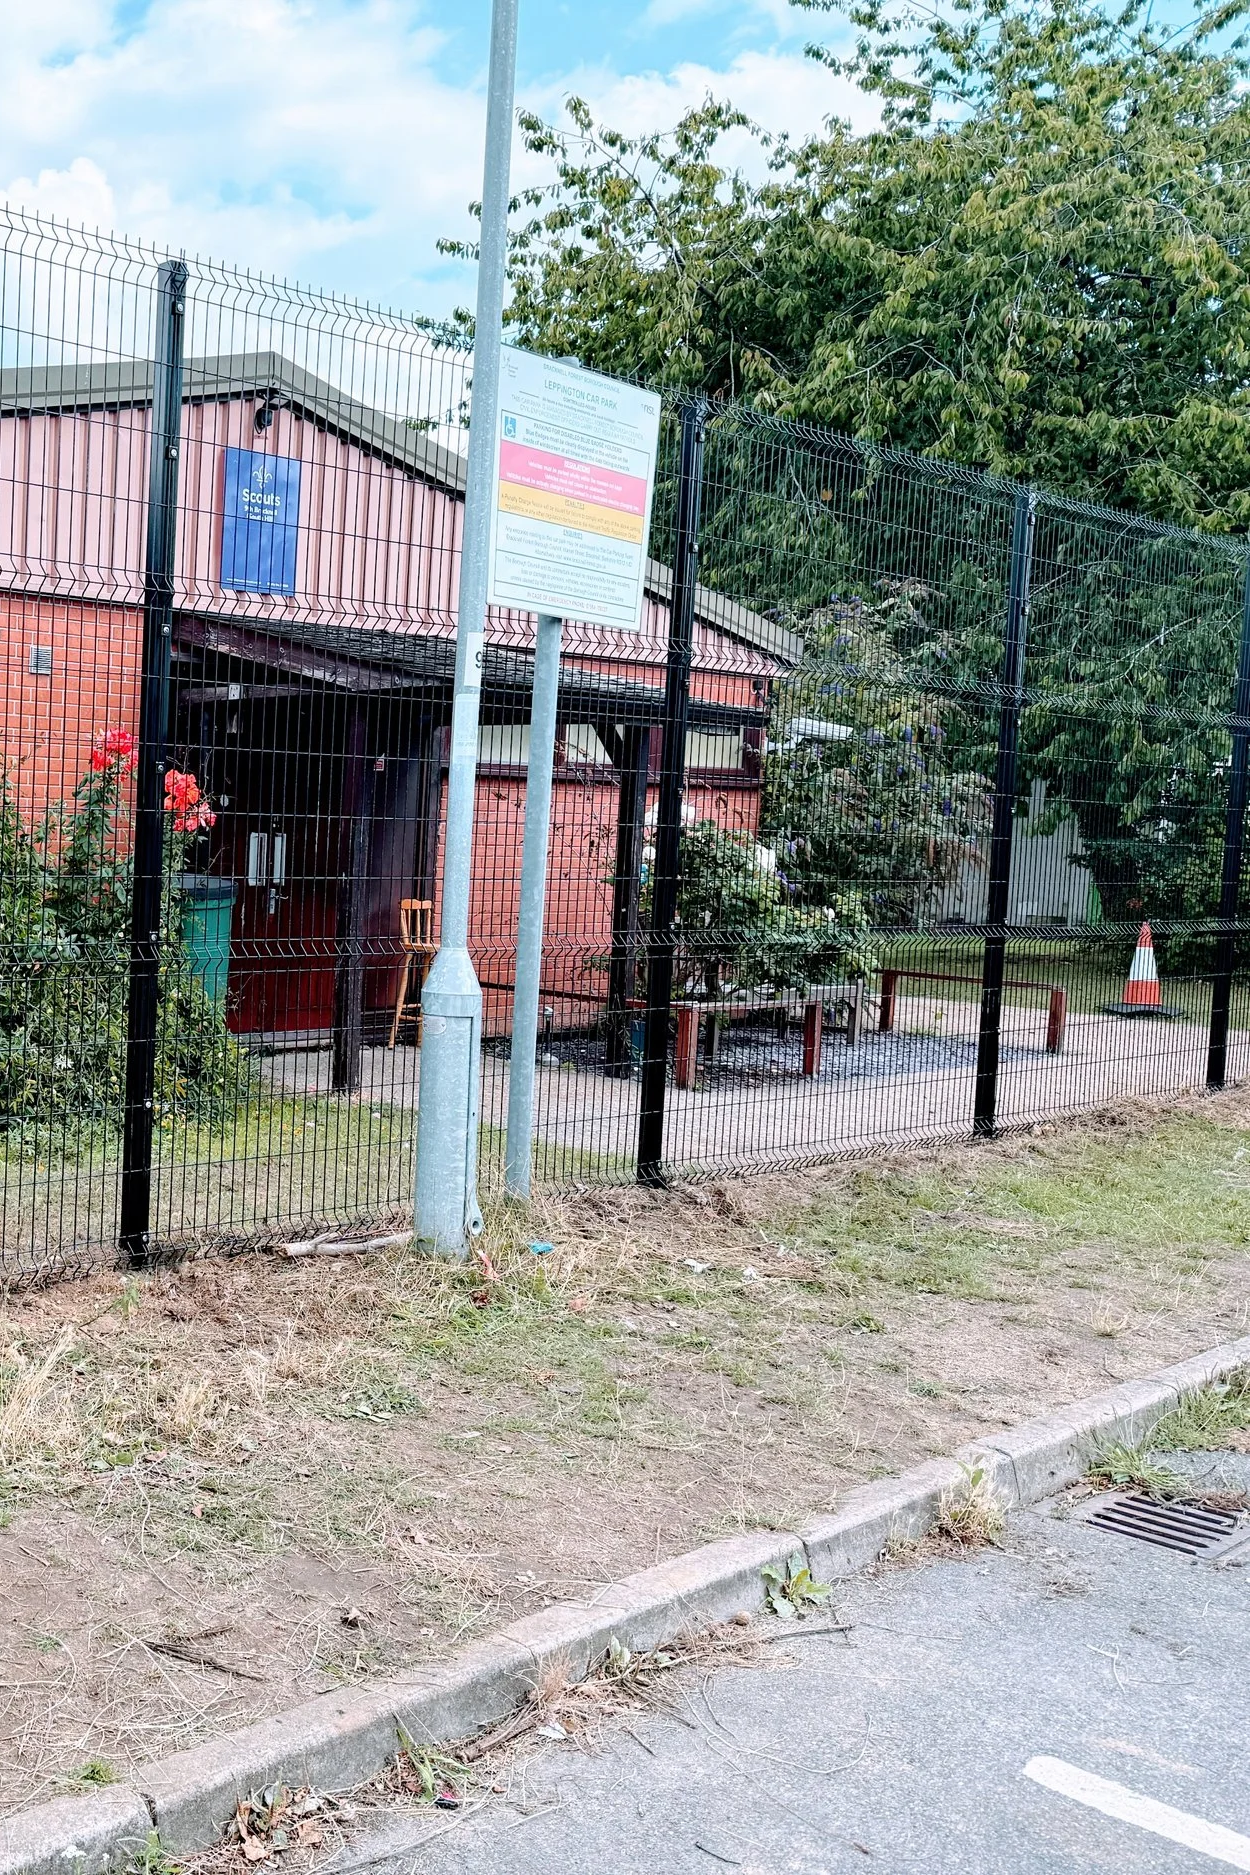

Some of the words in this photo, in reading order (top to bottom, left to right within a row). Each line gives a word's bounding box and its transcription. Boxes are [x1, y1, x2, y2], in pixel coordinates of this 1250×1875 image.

[544, 379, 584, 400] LEPPINGTON
[586, 393, 599, 404] CAR
[600, 397, 617, 410] PARK
[242, 488, 281, 507] Scouts
